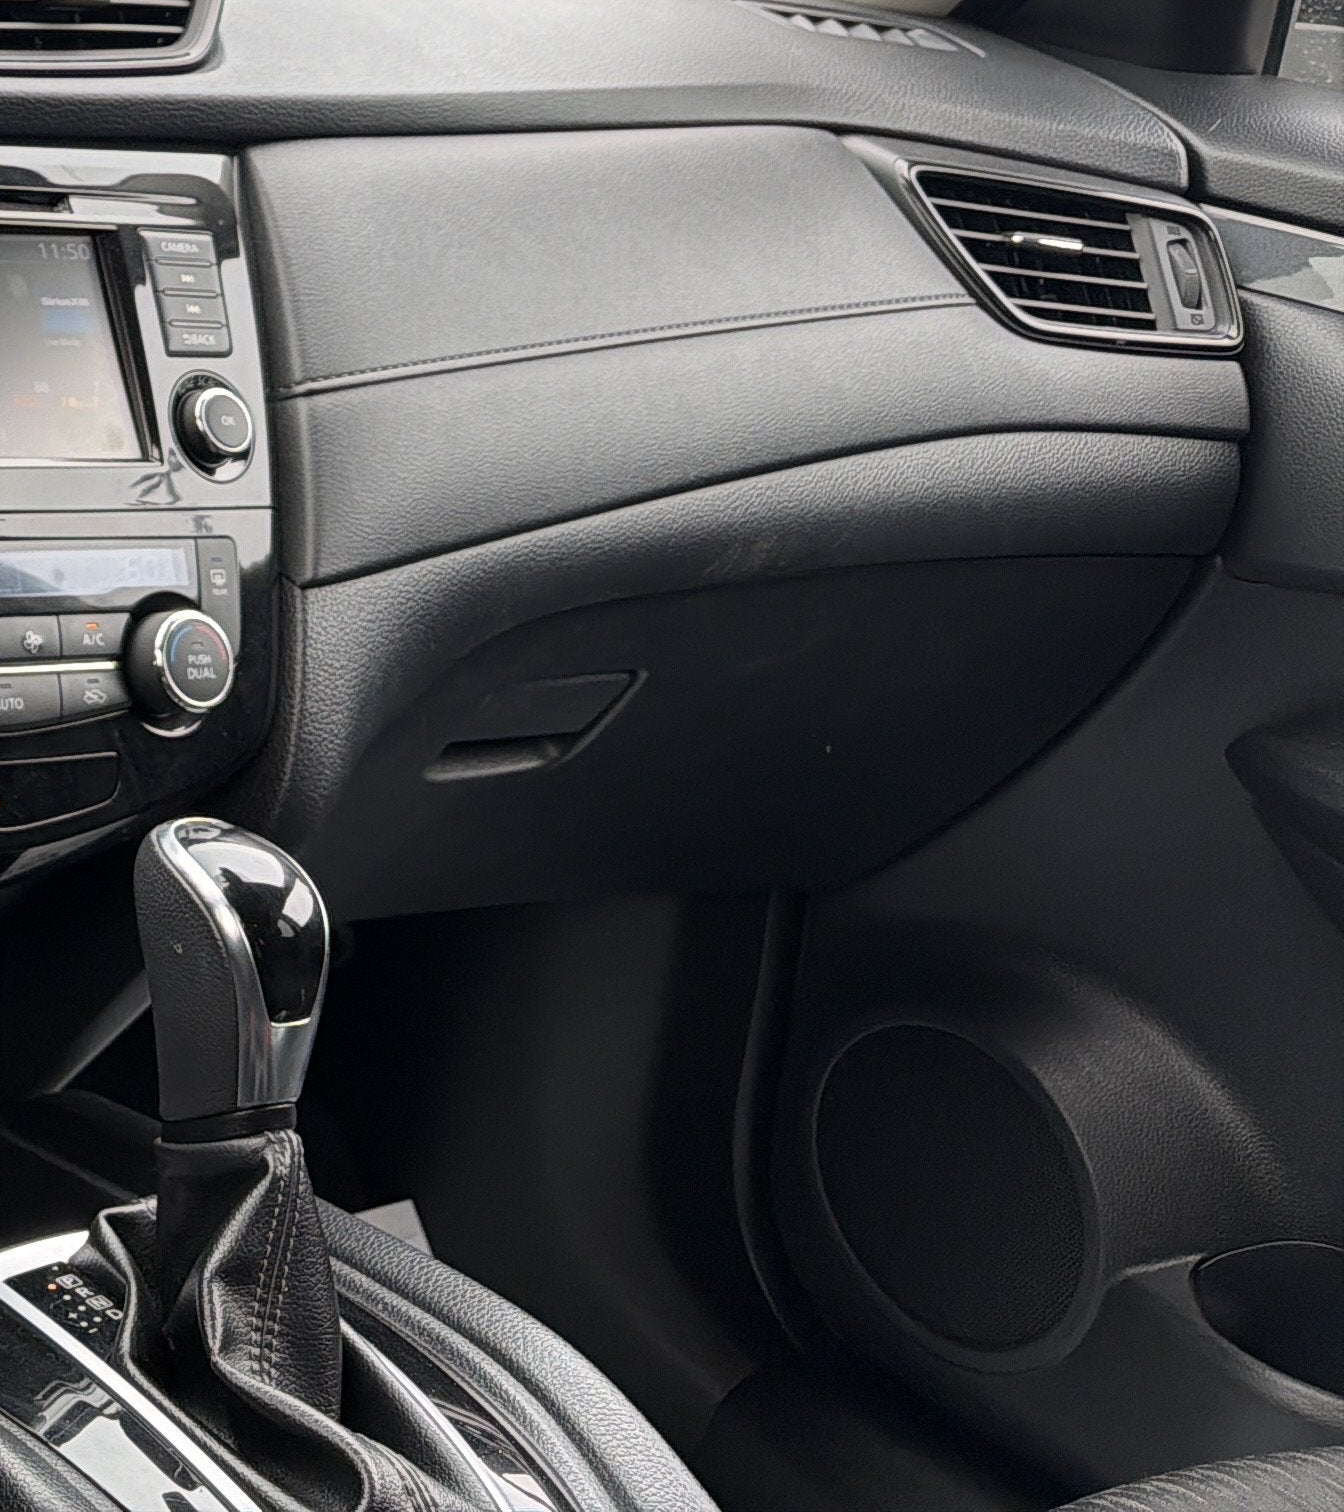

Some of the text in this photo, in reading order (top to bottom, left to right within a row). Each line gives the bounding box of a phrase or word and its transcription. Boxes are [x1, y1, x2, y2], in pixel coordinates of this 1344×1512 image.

[37, 242, 91, 261] 11:50
[82, 632, 104, 647] A/C
[187, 654, 212, 666] PUSH
[187, 666, 216, 680] DUAL
